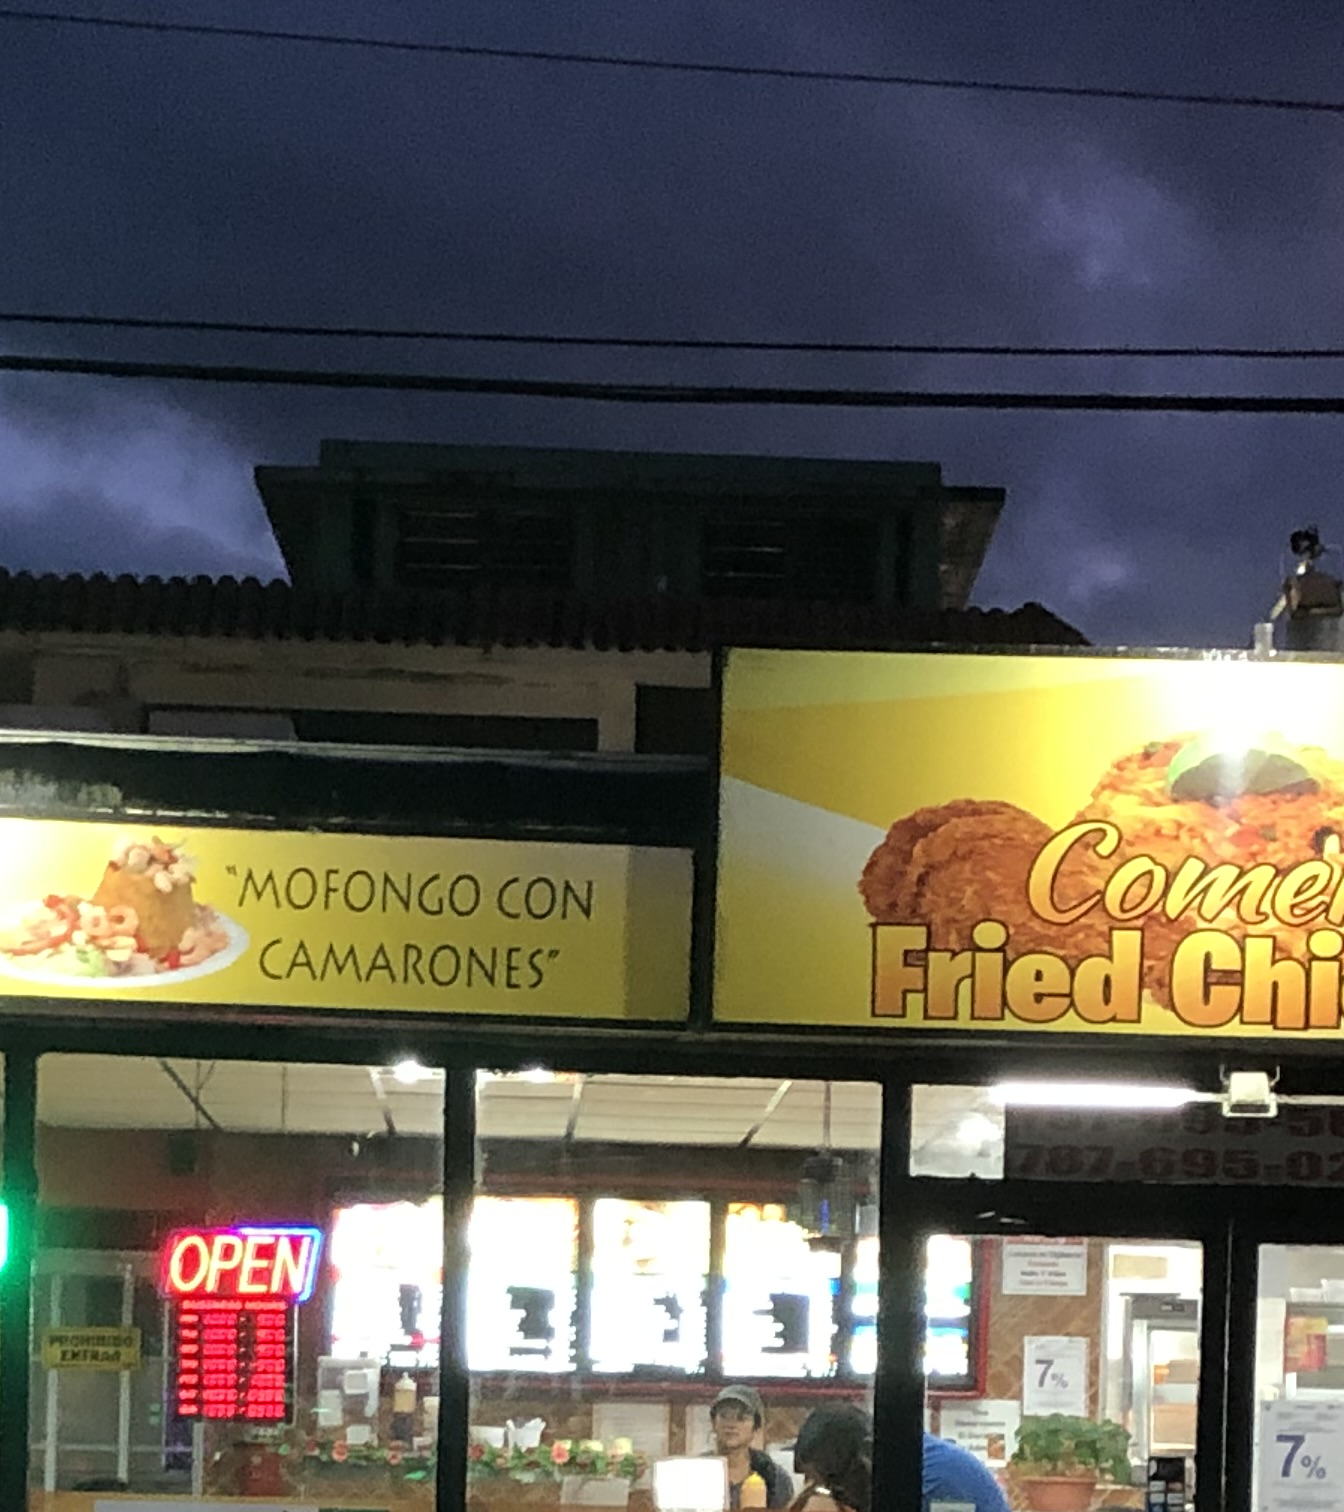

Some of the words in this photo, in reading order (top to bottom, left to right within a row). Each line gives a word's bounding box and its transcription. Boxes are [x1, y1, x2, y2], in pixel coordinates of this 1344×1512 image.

[496, 876, 595, 922] CON
[869, 921, 1143, 1024] Fried
[169, 1234, 312, 1294] OPEN
[1034, 1358, 1069, 1389] 7%
[1276, 1434, 1327, 1479] 7%
